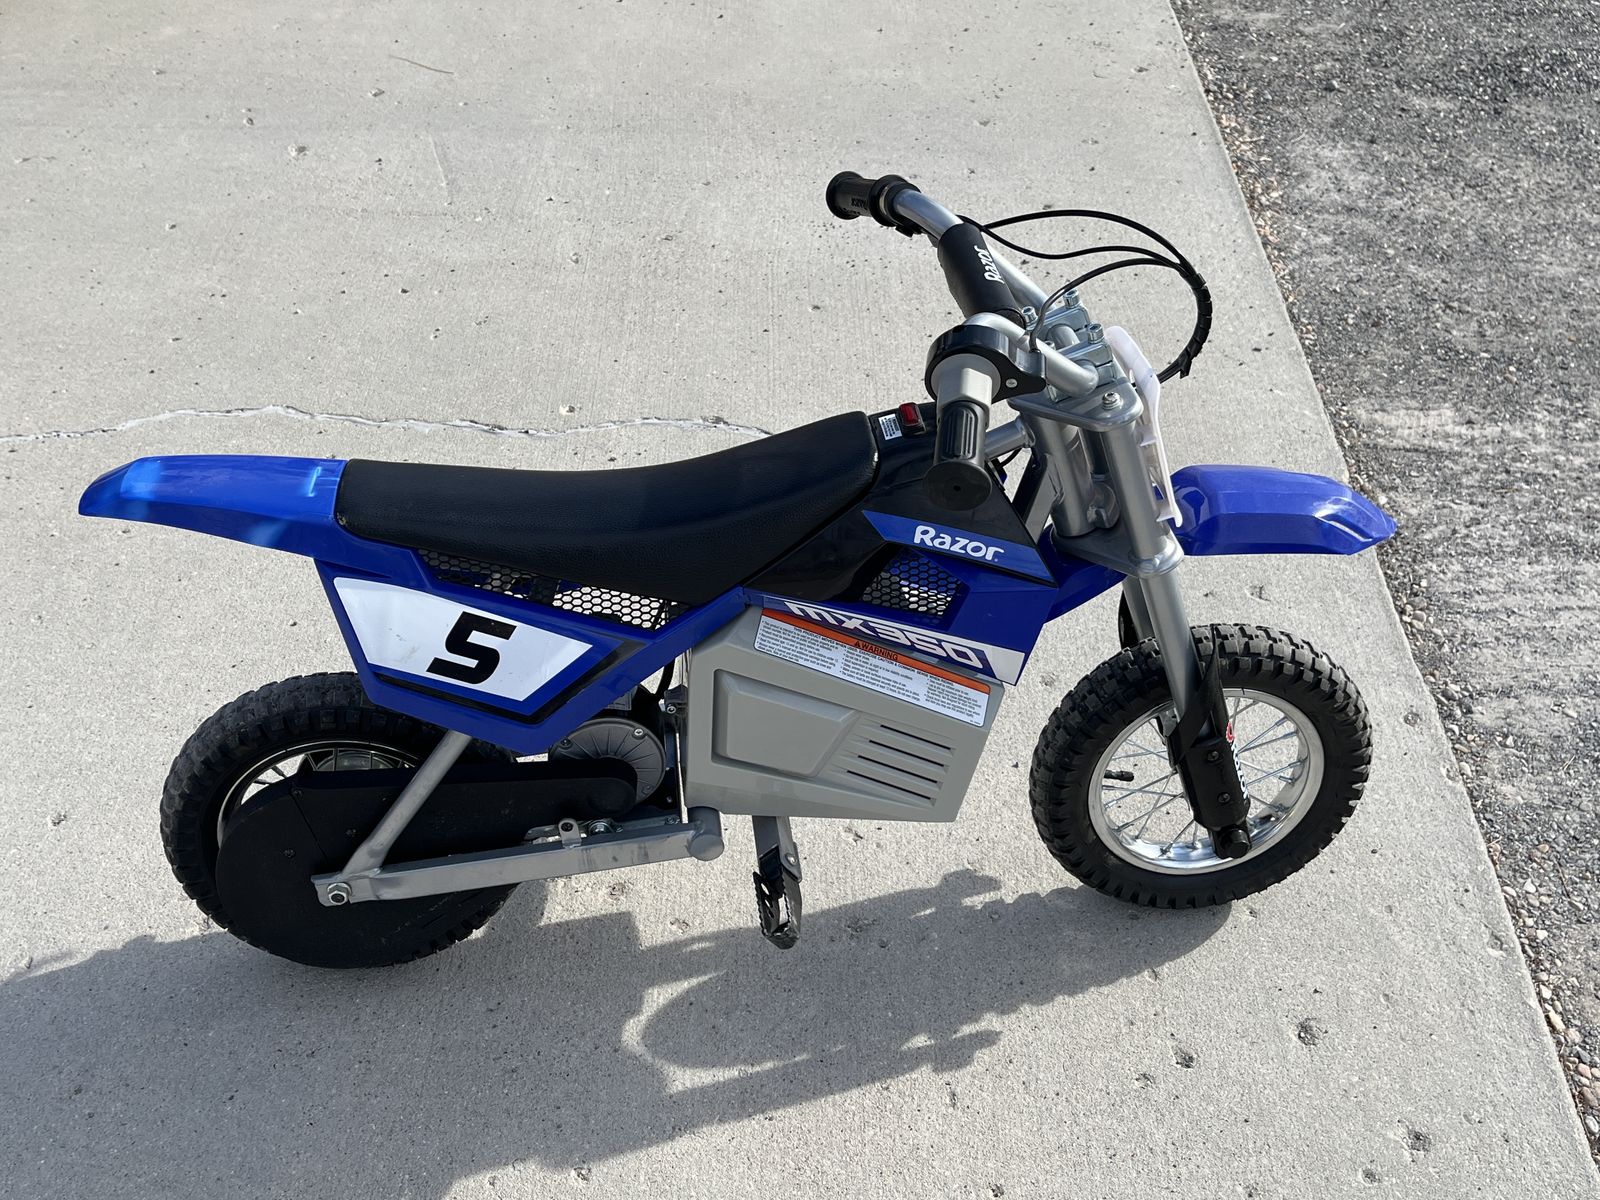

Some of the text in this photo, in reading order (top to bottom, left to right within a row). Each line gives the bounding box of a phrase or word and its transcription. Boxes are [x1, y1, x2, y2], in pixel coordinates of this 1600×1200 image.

[974, 245, 1005, 284] Razor
[914, 525, 1005, 561] Razor
[784, 601, 984, 669] MX350
[860, 642, 898, 661] WARNING
